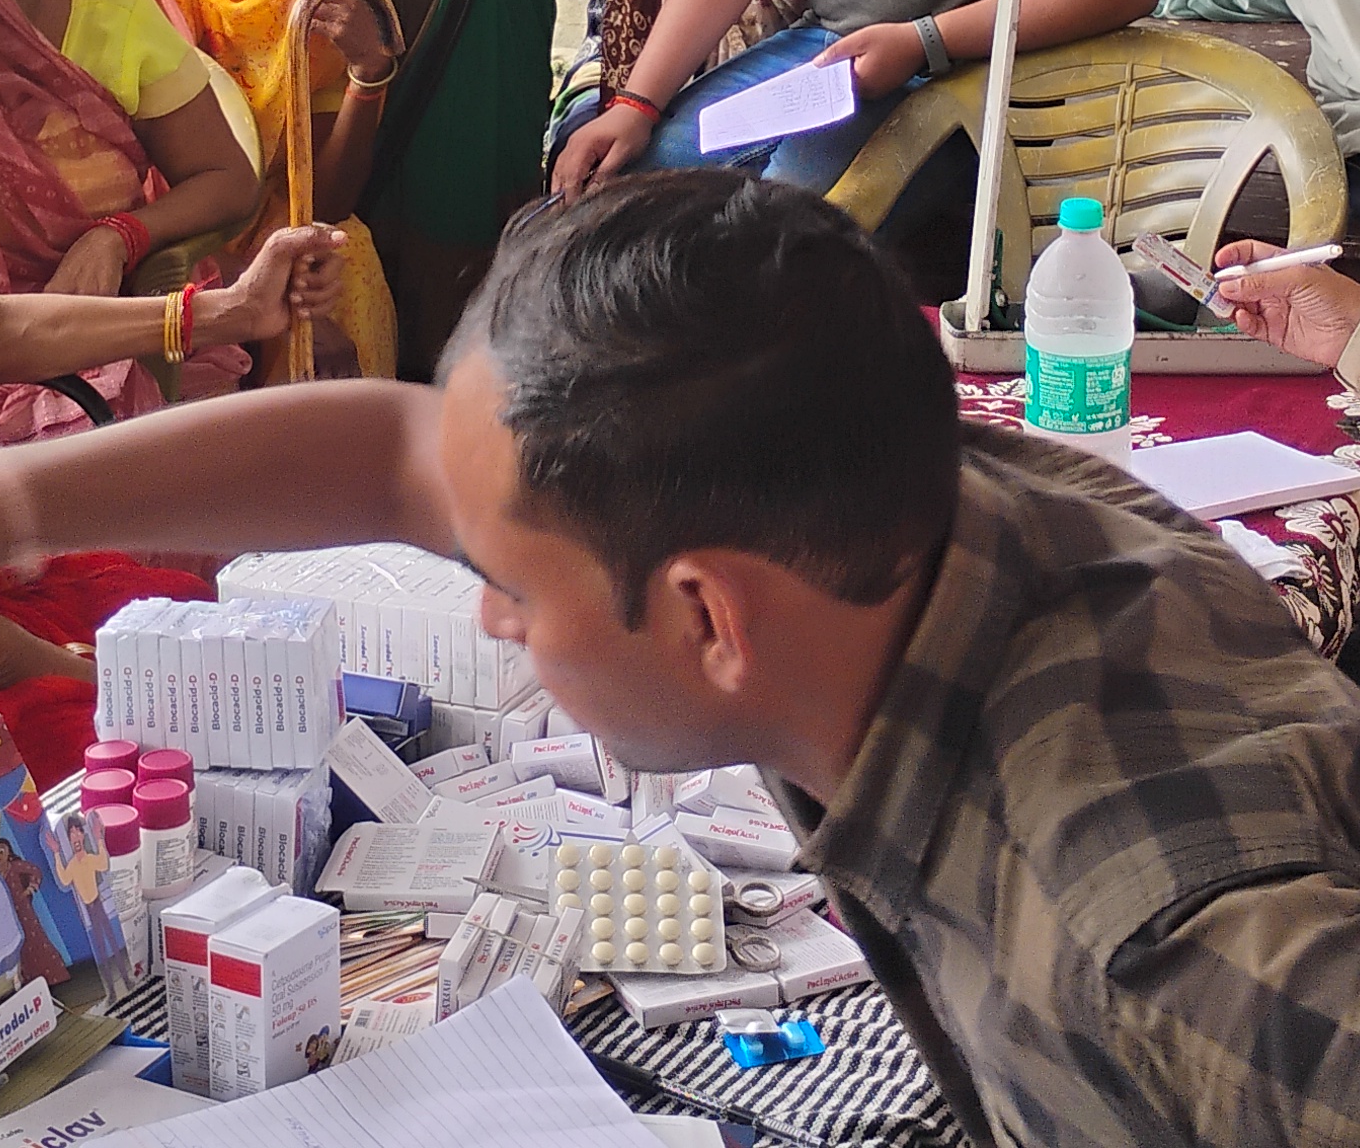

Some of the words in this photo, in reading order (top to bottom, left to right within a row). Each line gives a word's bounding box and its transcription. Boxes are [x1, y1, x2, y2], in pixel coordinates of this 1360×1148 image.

[533, 743, 566, 754] Pacimol
[458, 778, 486, 794] Pacimol
[709, 824, 739, 838] Pacimol
[807, 973, 840, 989] Pacimol
[272, 1005, 282, 1018] 50
